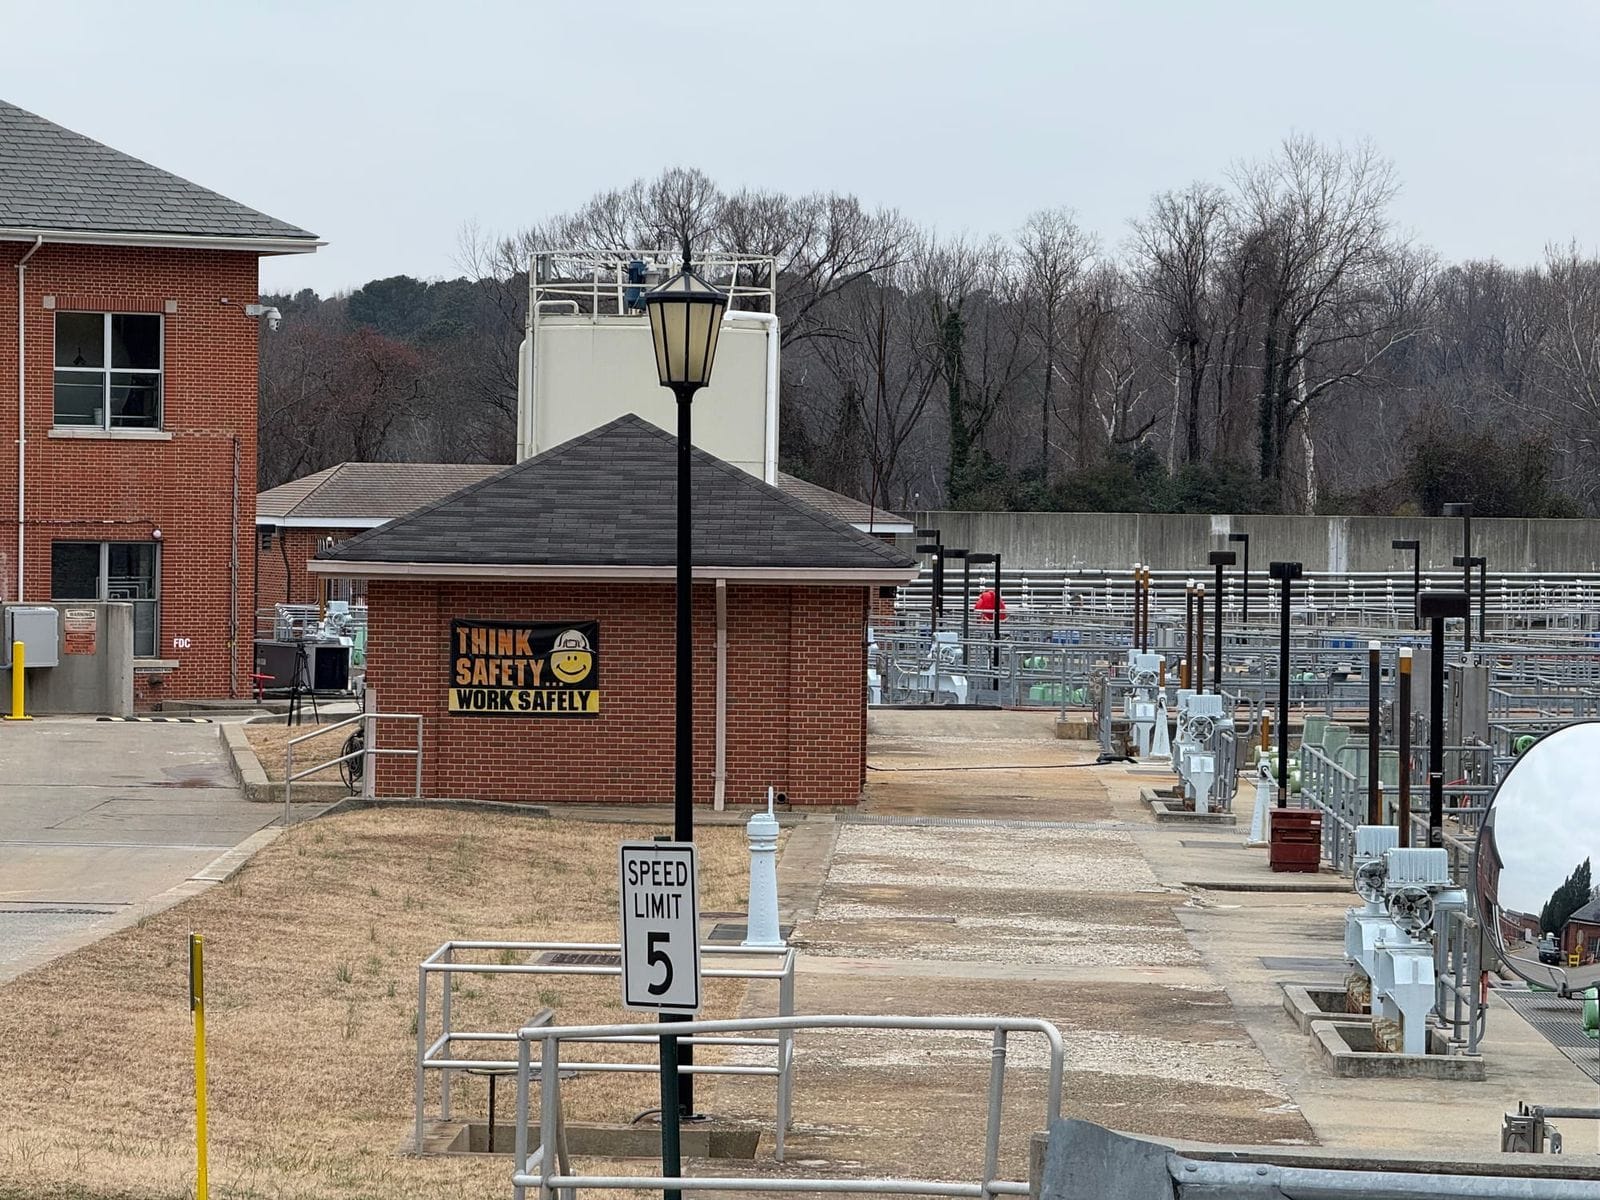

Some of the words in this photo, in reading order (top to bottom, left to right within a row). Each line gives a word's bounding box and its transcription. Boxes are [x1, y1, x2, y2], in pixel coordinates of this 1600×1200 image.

[173, 638, 191, 648] FDC
[457, 627, 533, 656] THINK
[457, 689, 514, 711] WORK
[518, 690, 592, 712] SAFELY
[628, 860, 688, 887] SPEED
[634, 892, 682, 919] LIMIT
[647, 931, 674, 996] 5
